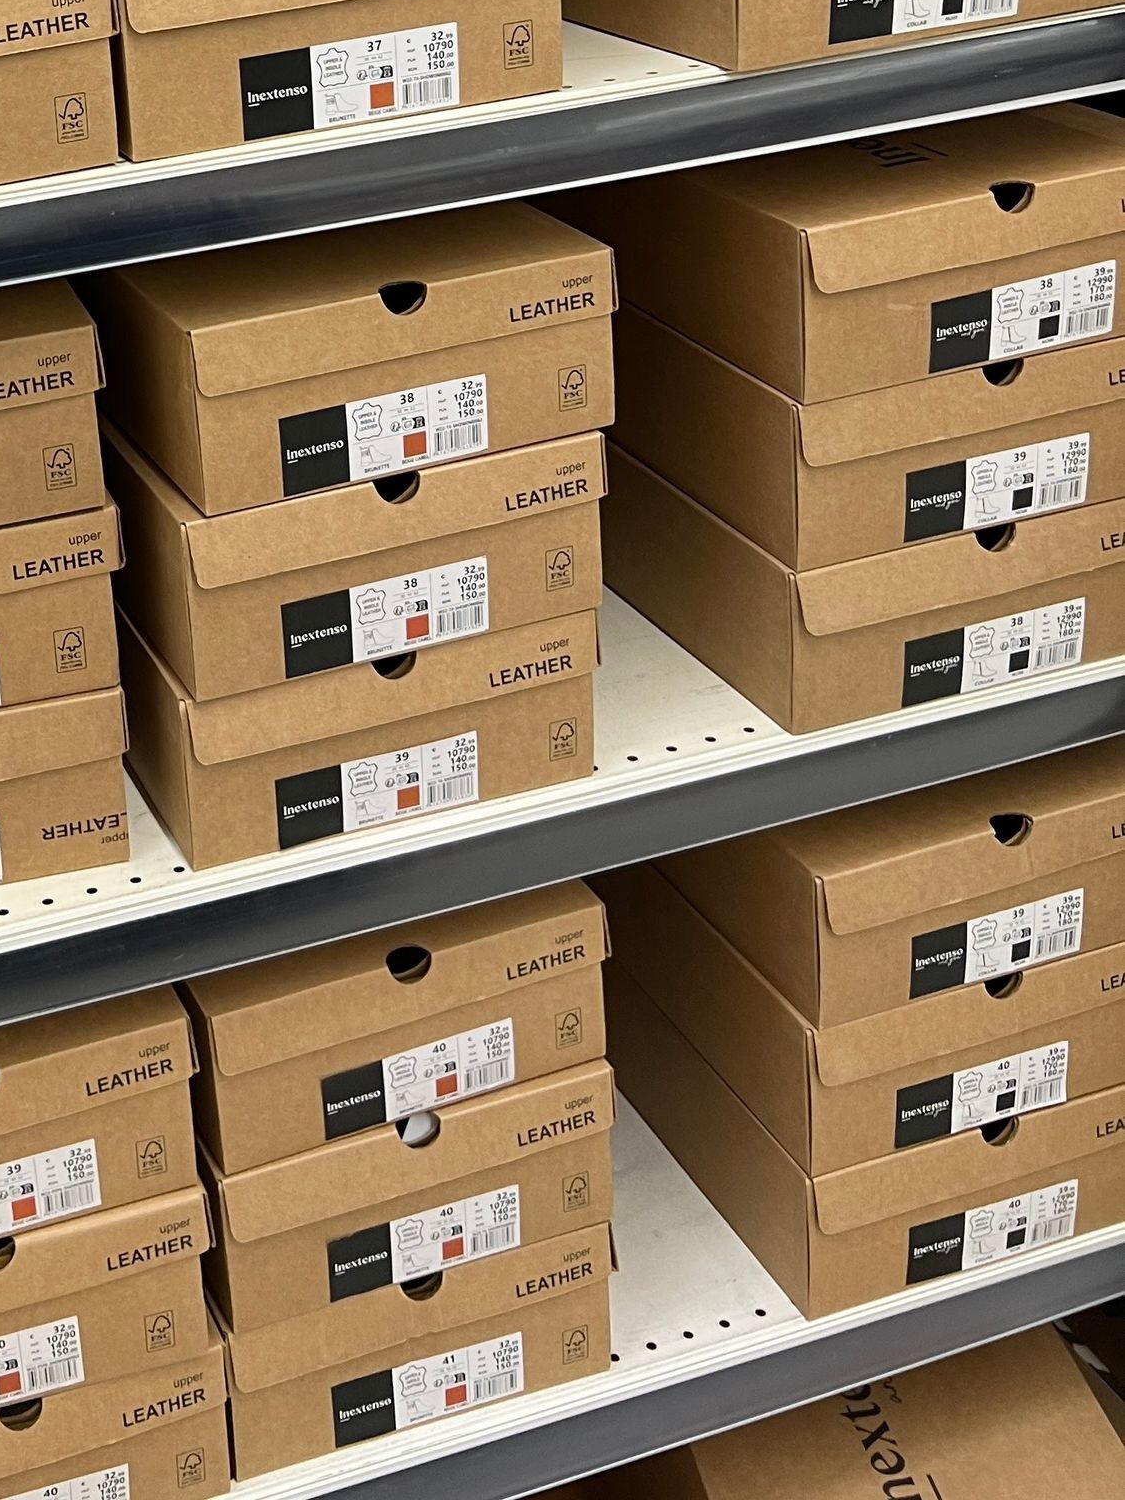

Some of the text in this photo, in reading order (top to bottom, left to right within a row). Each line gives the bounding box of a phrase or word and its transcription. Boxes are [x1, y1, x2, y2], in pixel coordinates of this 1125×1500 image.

[368, 40, 381, 52] 37
[248, 86, 307, 106] Inextenso
[562, 275, 593, 288] upper
[1041, 279, 1052, 289] 38
[510, 292, 594, 322] LEATHER
[937, 320, 987, 340] Inextenso
[38, 353, 70, 367] upper
[401, 393, 414, 404] 38
[287, 440, 343, 463] Inextenso
[1014, 452, 1026, 462] 39
[506, 479, 588, 511] LEATHER
[911, 491, 961, 509] Inextenso
[13, 549, 104, 580] LEATHER
[404, 578, 417, 589] 38
[291, 625, 347, 647] Inextenso
[540, 639, 569, 652] upper
[490, 655, 572, 687] LEATHER
[396, 752, 409, 762] 39
[284, 796, 339, 818] Inextenso
[41, 812, 127, 841] EATHER
[1013, 909, 1024, 919] 39
[555, 930, 583, 944] upper
[507, 946, 585, 980] LEATHER
[139, 1043, 170, 1058] upper
[433, 1043, 446, 1052] 40
[998, 1061, 1009, 1070] 40
[86, 1059, 173, 1096] LEATHER
[902, 1100, 949, 1120] Inextenso
[518, 1111, 595, 1146] LEATHER
[8, 1164, 21, 1175] 39
[107, 1235, 192, 1271] LEATHER
[564, 1248, 590, 1262] upper
[335, 1252, 387, 1275] Inextenso
[516, 1263, 592, 1297] LEATHER
[443, 1355, 454, 1364] 41
[174, 1373, 203, 1388] upper
[123, 1389, 205, 1427] LEATHER
[340, 1398, 391, 1422] Inextenso
